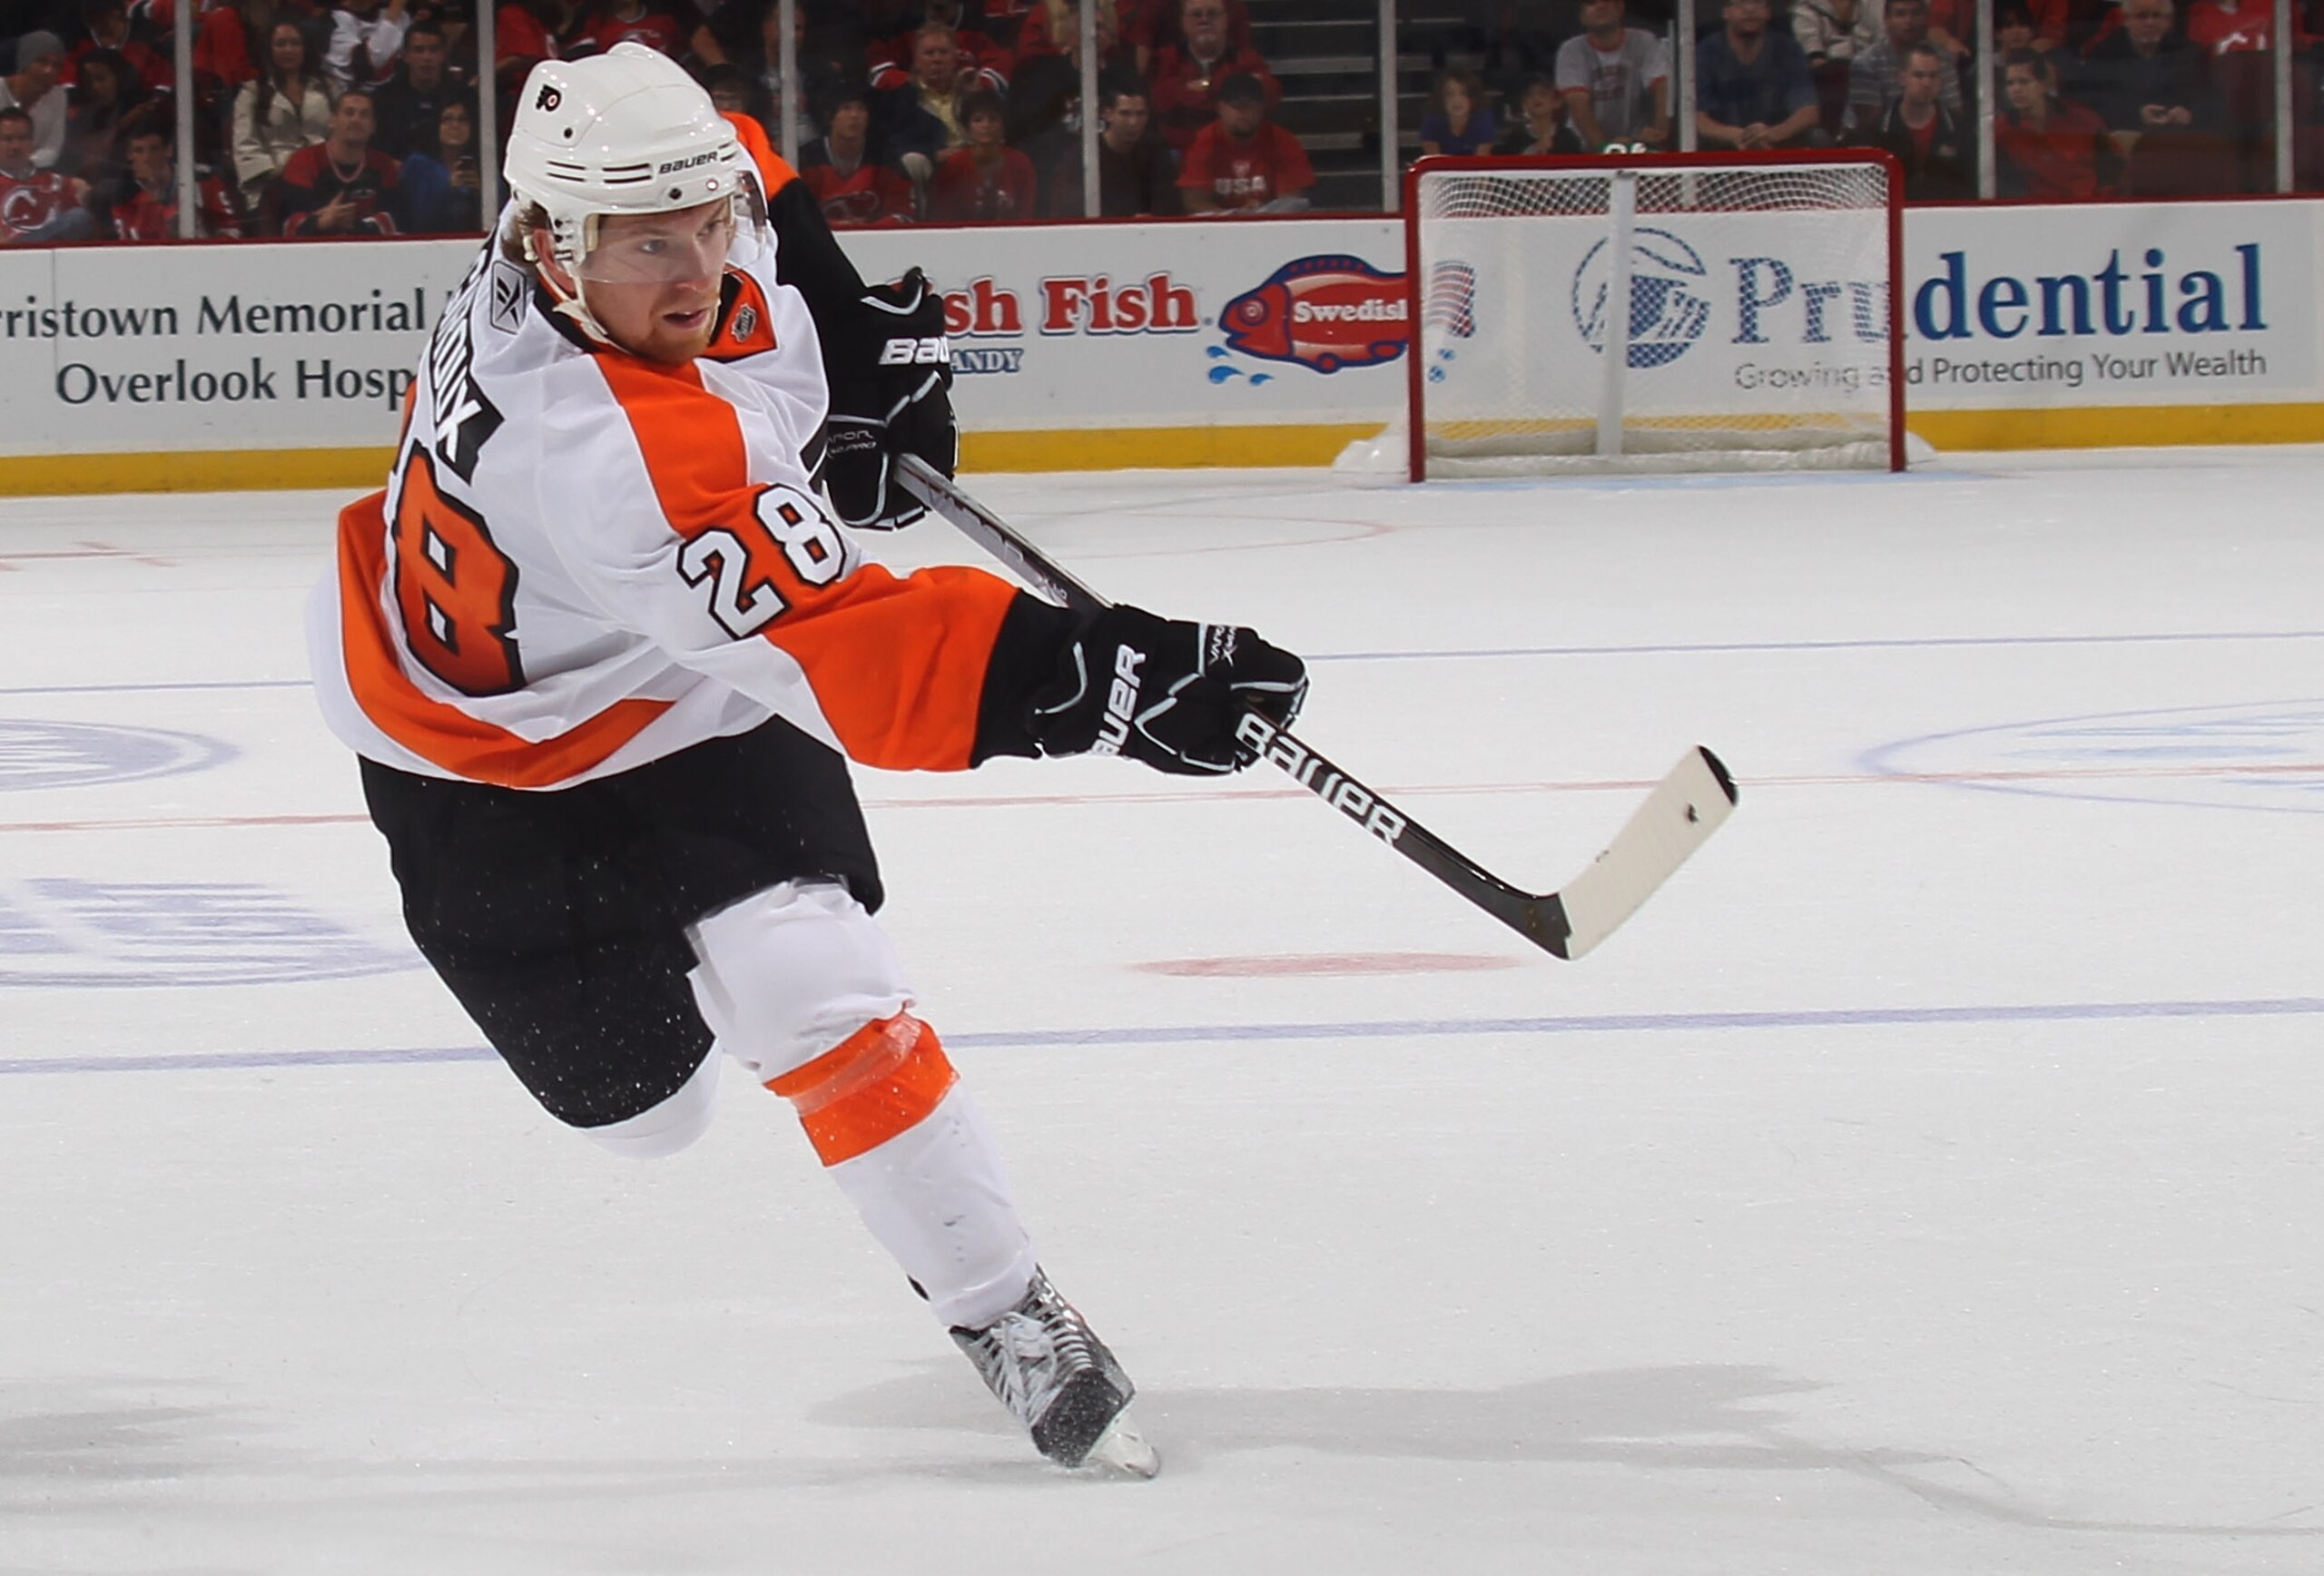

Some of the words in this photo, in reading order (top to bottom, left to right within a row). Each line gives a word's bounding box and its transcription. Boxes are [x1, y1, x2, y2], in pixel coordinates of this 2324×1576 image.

[1215, 175, 1266, 194] USA
[0, 295, 178, 339] ristown
[197, 287, 425, 335] Memorial
[1039, 271, 1199, 336] Fish
[1728, 243, 2268, 345] Prudential
[56, 357, 276, 404] Overlook
[1735, 362, 1859, 395] Growing
[1869, 359, 1924, 386] ad
[1934, 356, 2083, 388] Protecting
[2093, 352, 2158, 379] Your
[2165, 349, 2267, 377] Wealth
[676, 483, 847, 642] 28
